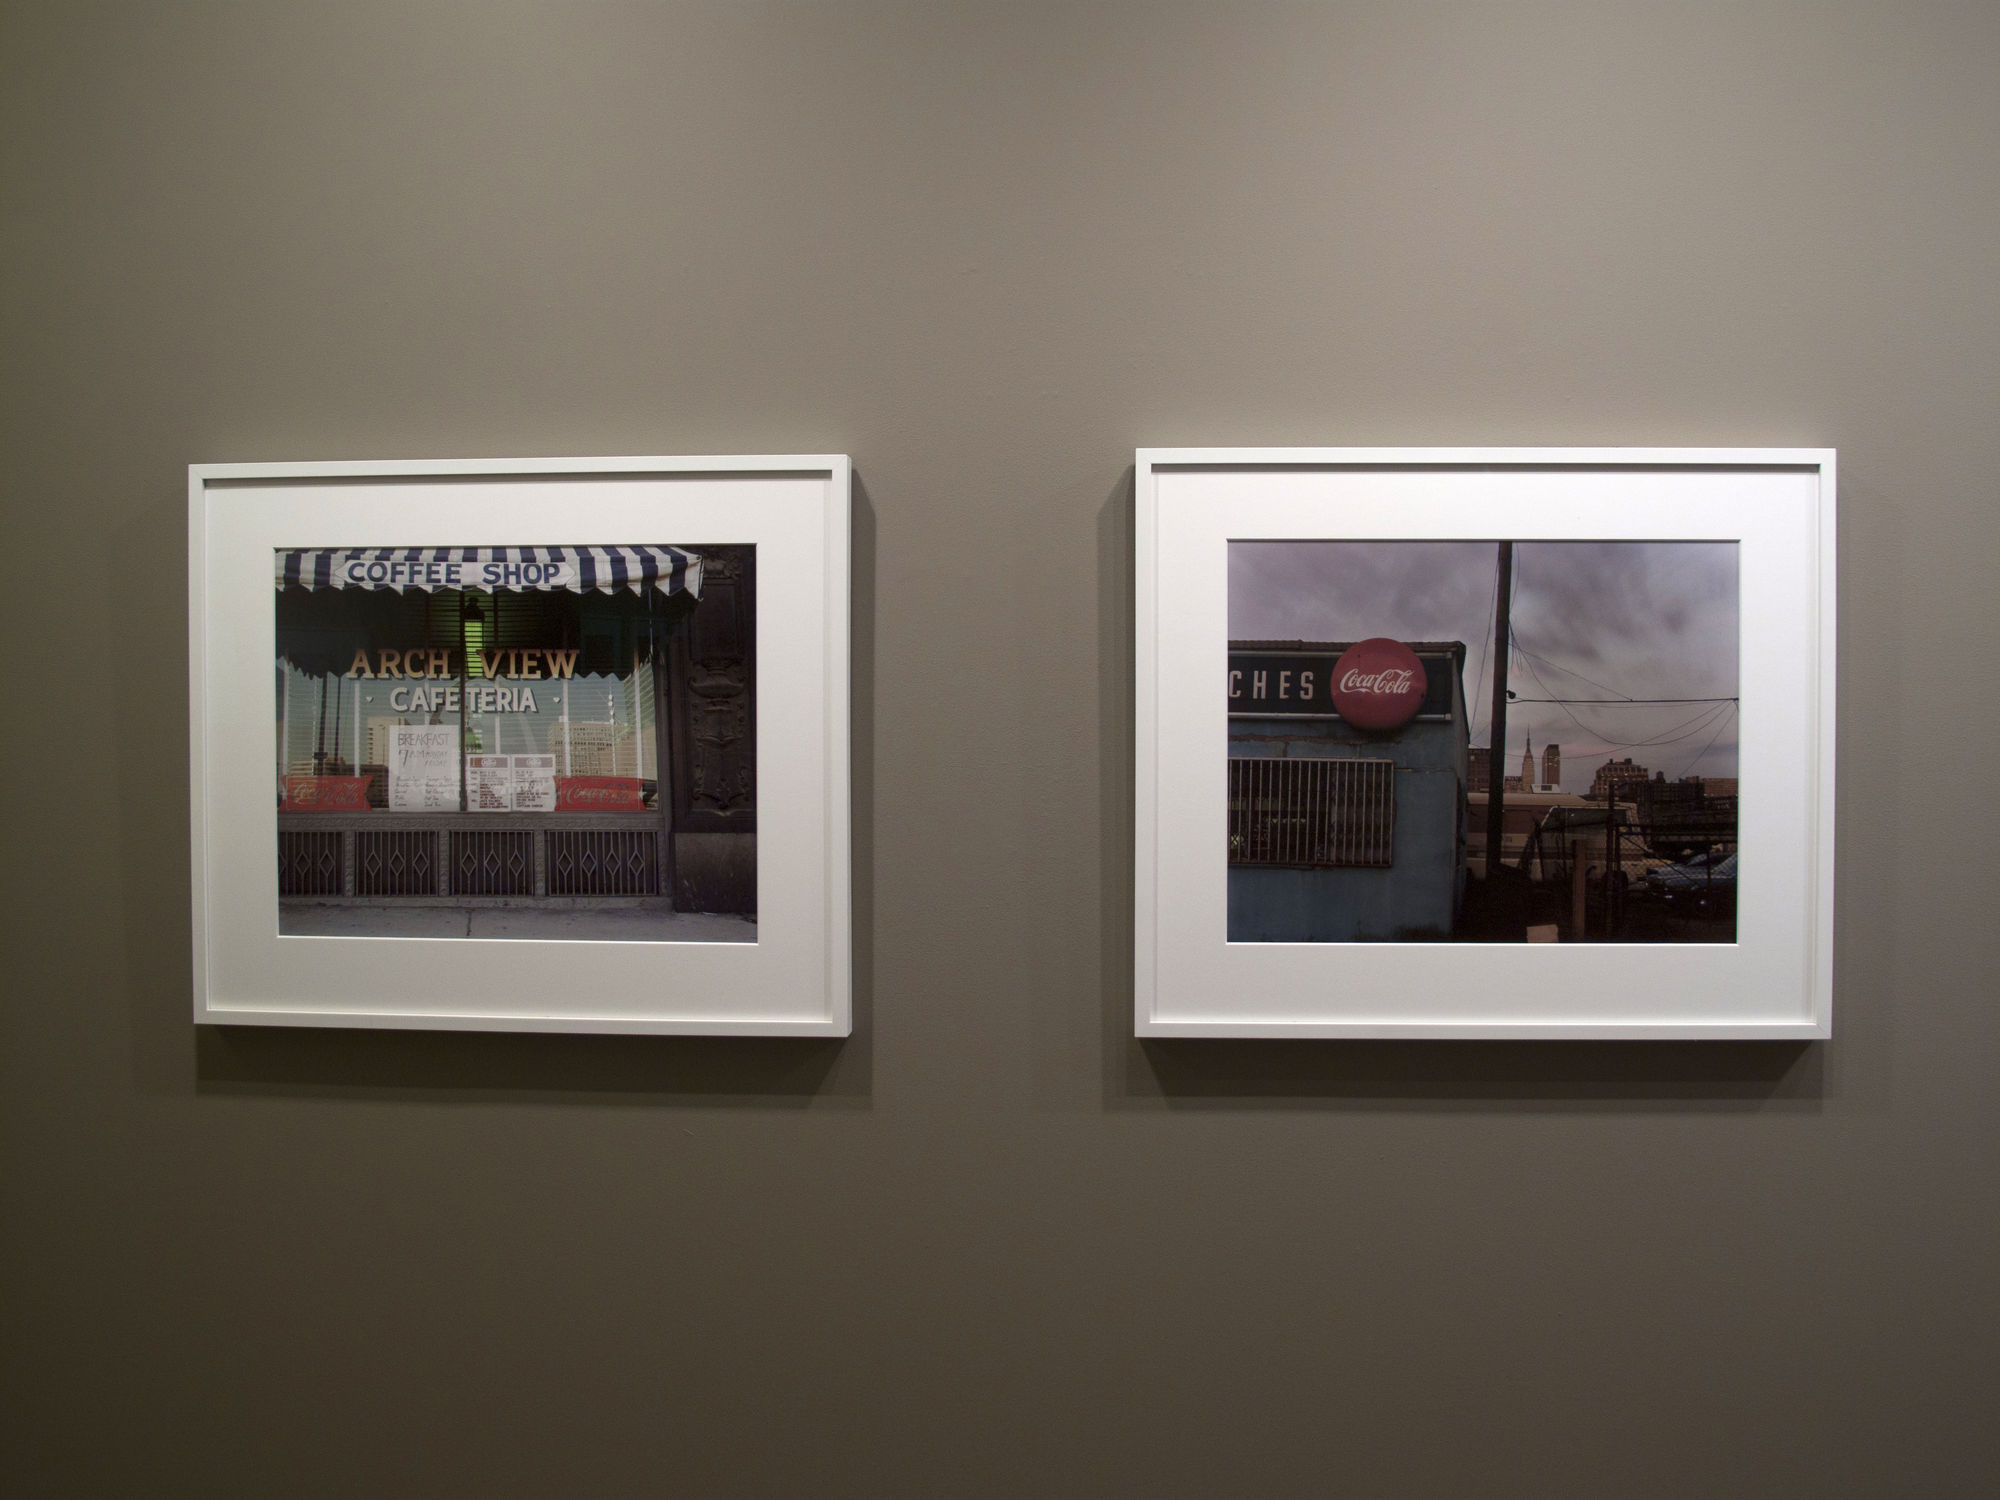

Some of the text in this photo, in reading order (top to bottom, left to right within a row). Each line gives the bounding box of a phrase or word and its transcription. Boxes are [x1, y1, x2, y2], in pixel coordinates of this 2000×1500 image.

[347, 562, 561, 585] COFFEE SHOP
[346, 649, 580, 680] ARCH VIEW
[1228, 670, 1314, 700] CHES
[1339, 668, 1414, 695] Coca-Cola
[398, 733, 449, 746] BREAKFAST
